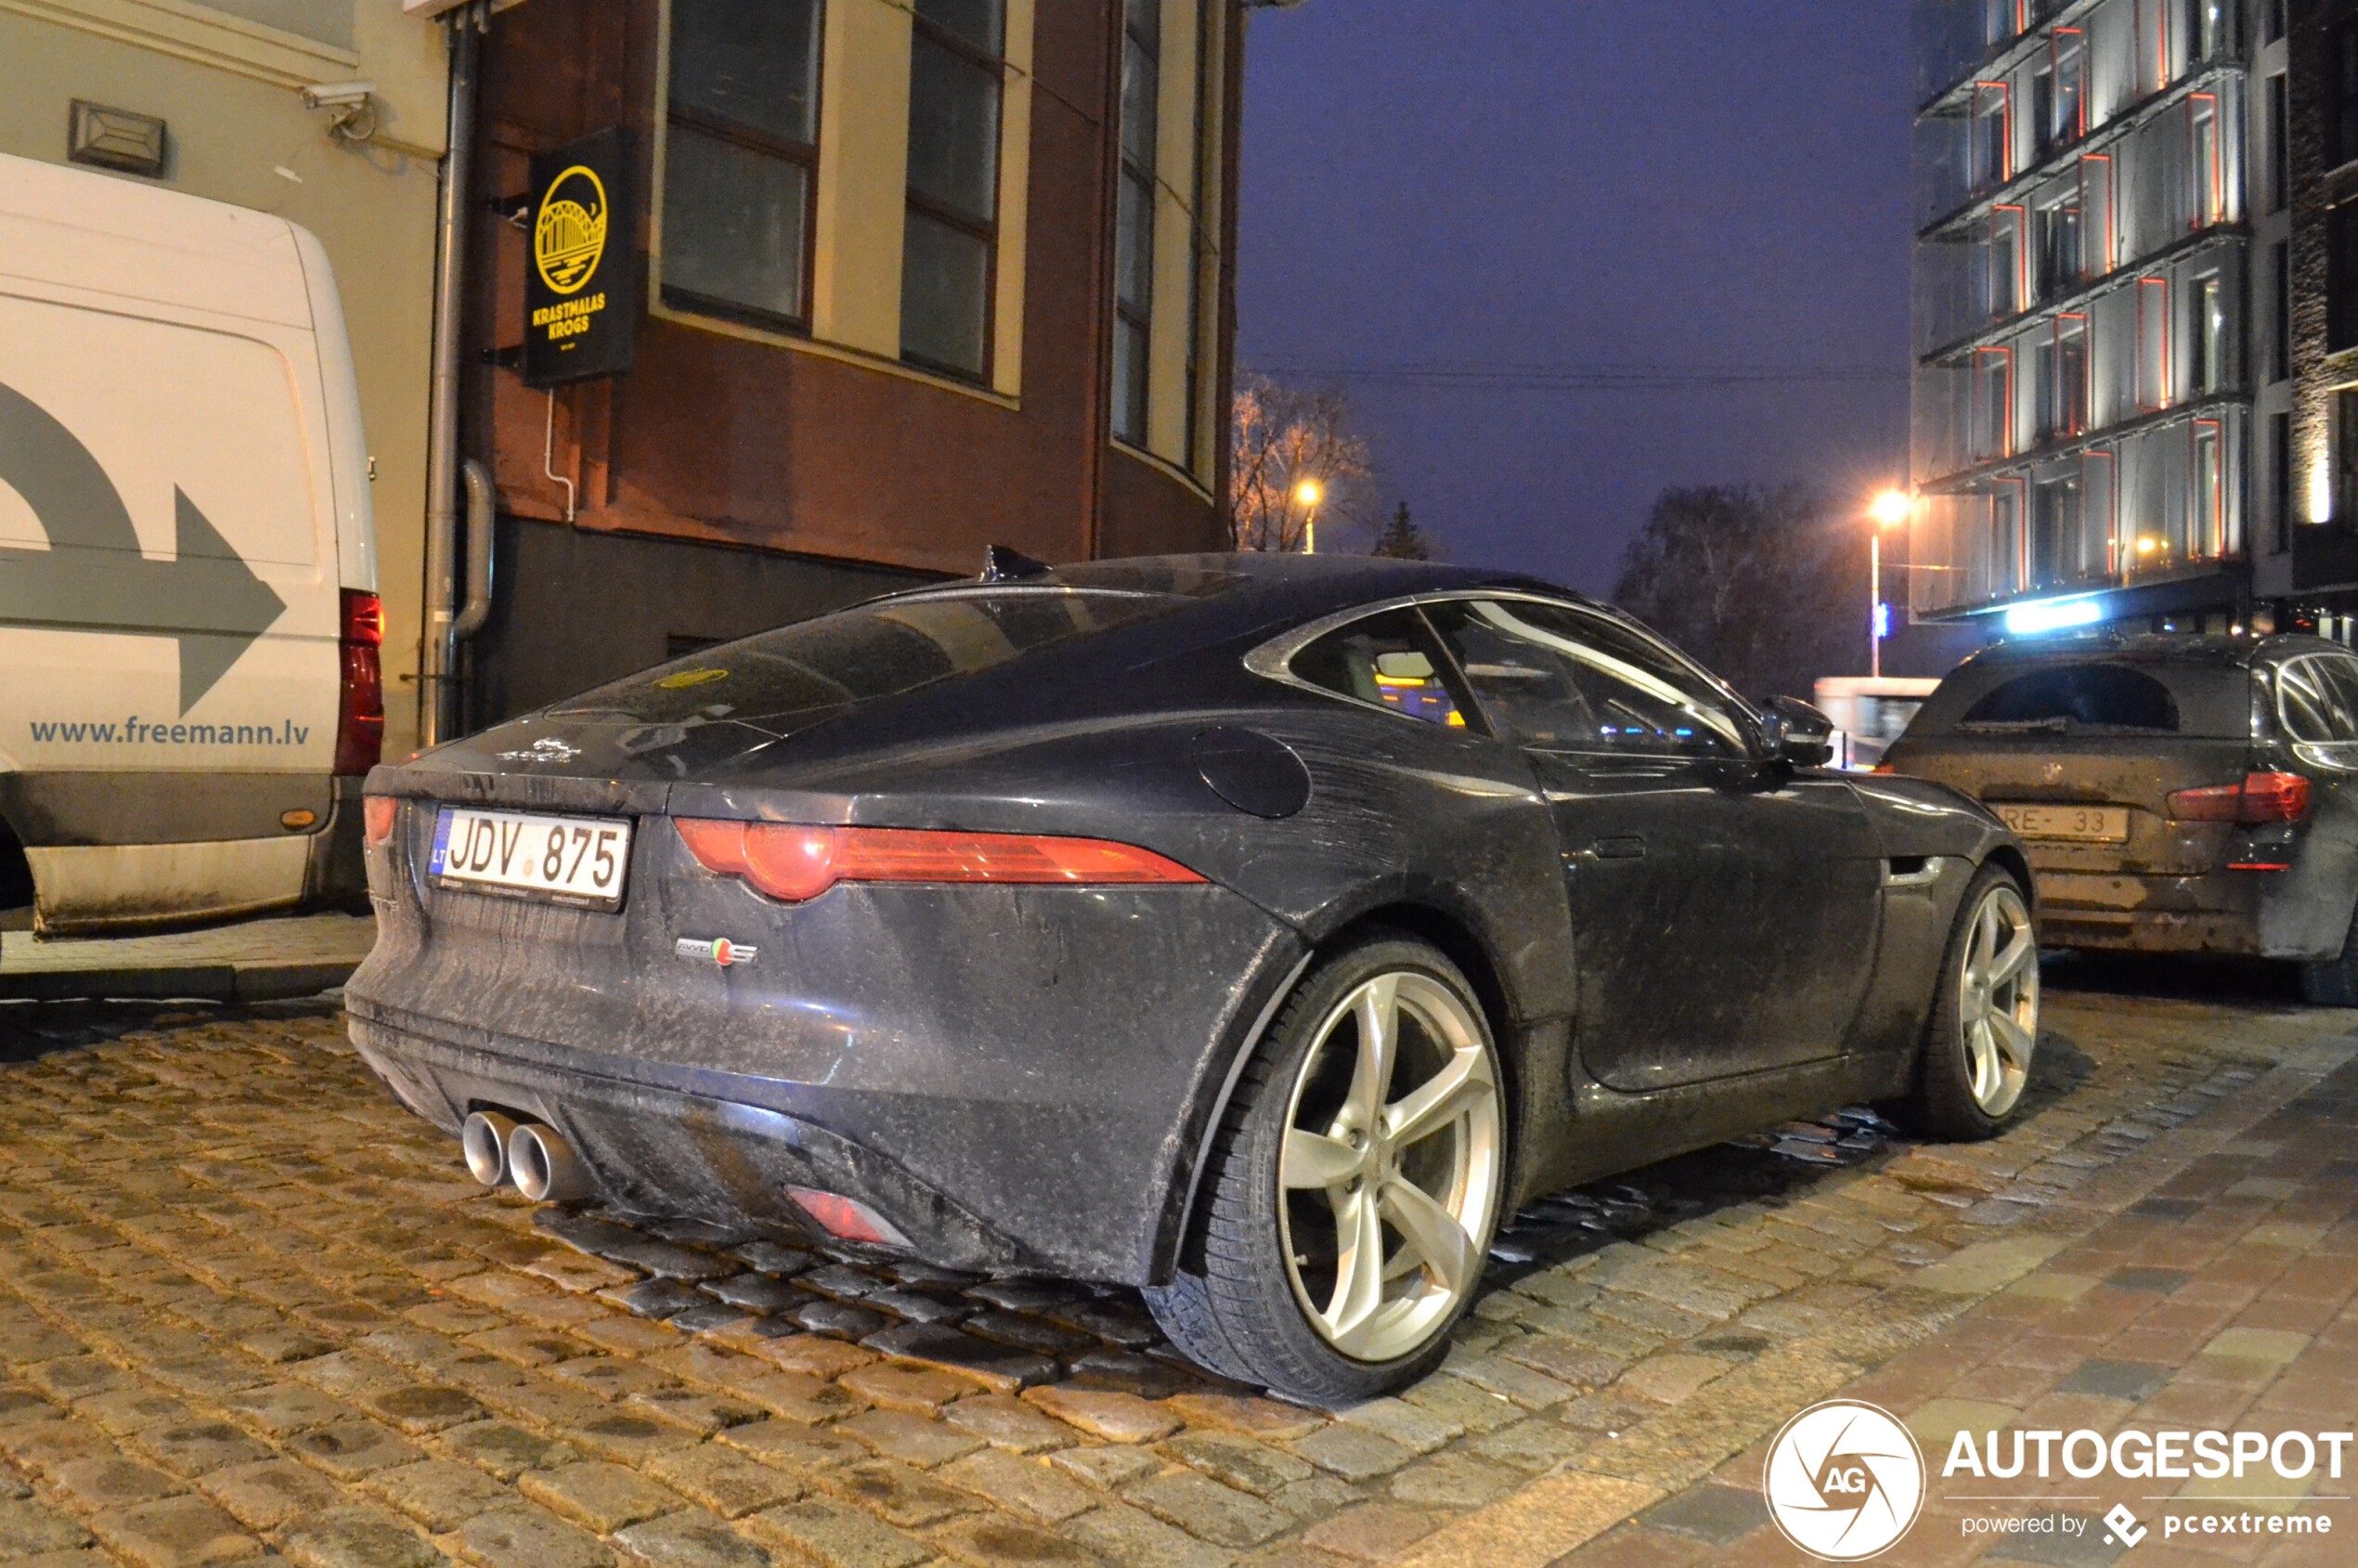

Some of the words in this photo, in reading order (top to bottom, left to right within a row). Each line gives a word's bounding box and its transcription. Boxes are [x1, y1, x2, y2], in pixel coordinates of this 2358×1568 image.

[533, 292, 605, 327] KRASTMALAS
[549, 315, 590, 340] KROGS
[30, 716, 309, 745] www.freemann.lv
[2074, 810, 2105, 833] 33
[432, 849, 447, 864] LT
[450, 817, 524, 875] JDV
[543, 824, 617, 888] 875
[678, 942, 709, 953] AWD
